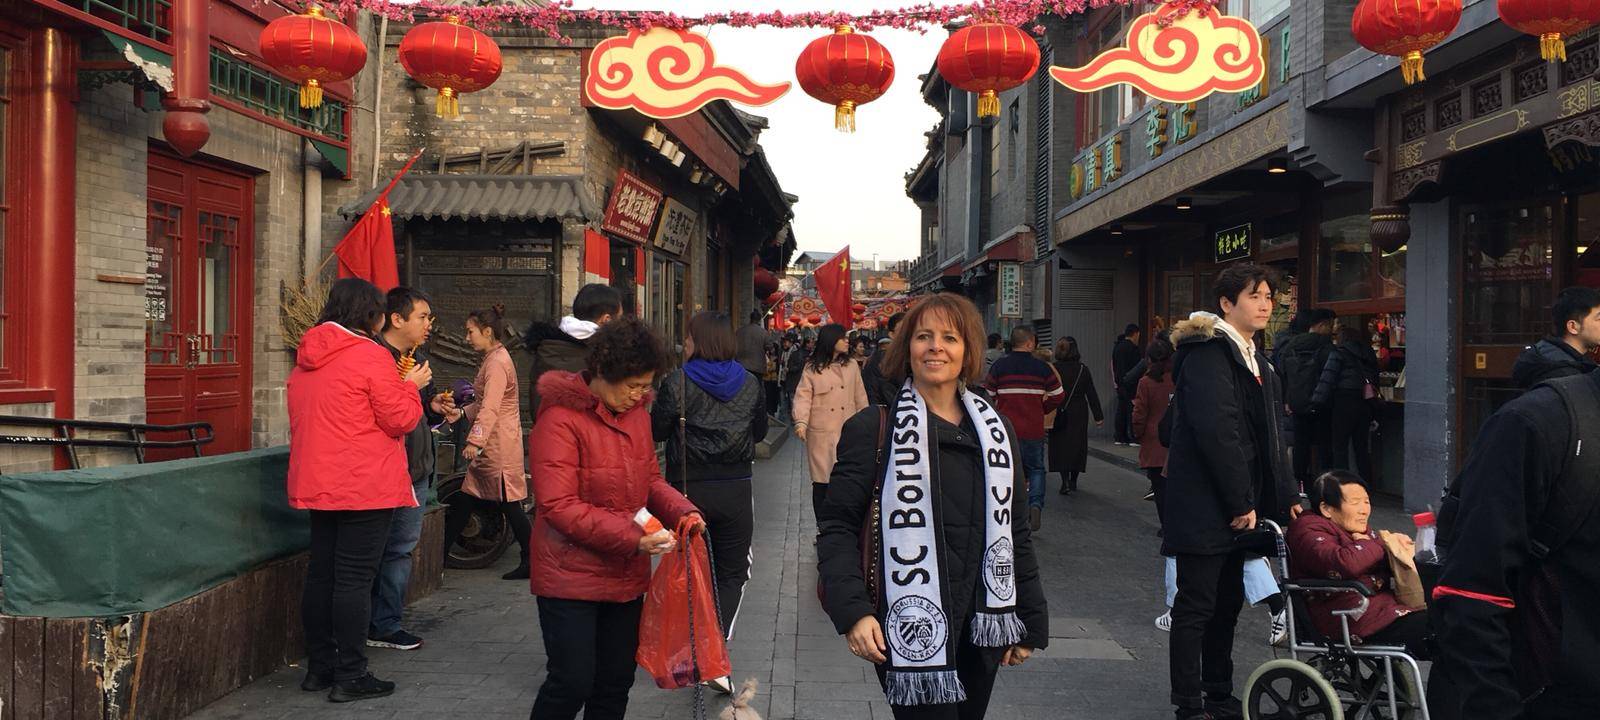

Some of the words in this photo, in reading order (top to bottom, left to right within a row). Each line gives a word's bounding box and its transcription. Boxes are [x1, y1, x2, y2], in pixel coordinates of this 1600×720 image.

[1218, 230, 1247, 254] 特色小吃
[991, 485, 1011, 526] SC
[889, 545, 931, 586] SC
